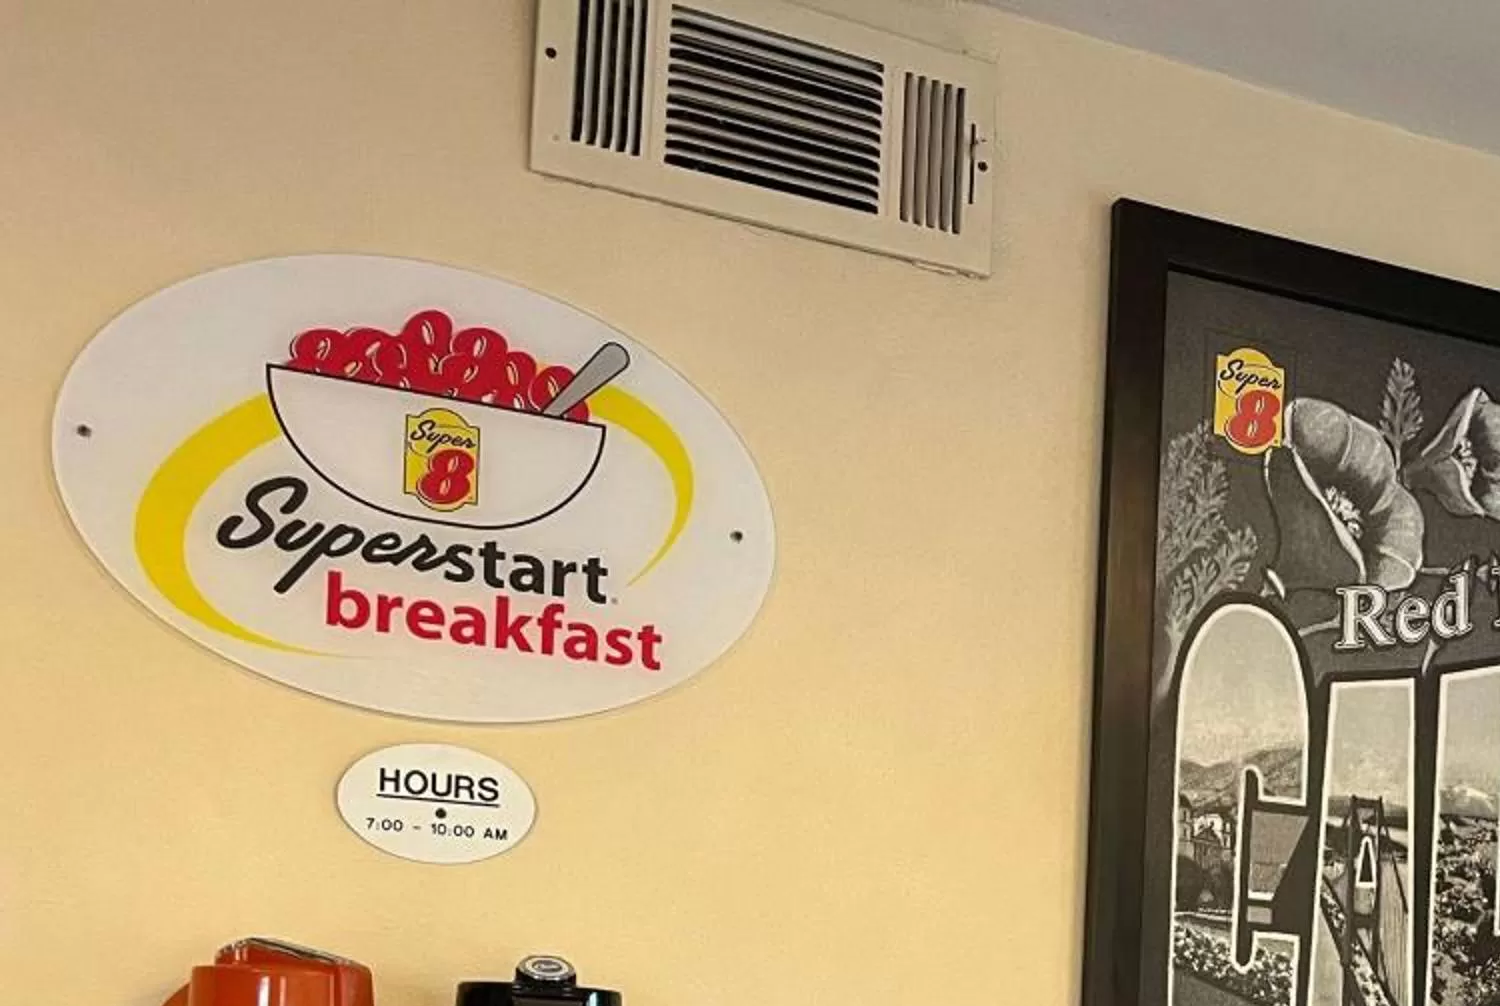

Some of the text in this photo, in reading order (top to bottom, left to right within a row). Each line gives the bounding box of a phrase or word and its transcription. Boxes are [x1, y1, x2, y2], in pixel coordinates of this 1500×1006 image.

[1219, 361, 1282, 391] Super
[408, 419, 478, 451] Super
[1226, 389, 1282, 447] 8
[415, 449, 475, 505] 8
[216, 476, 611, 603] Superstart
[325, 570, 662, 671] breakfast
[1333, 572, 1474, 651] Red
[379, 767, 500, 803] HOURS
[366, 817, 404, 832] 7:00
[430, 822, 475, 838] 10:00
[483, 827, 508, 841] AM
